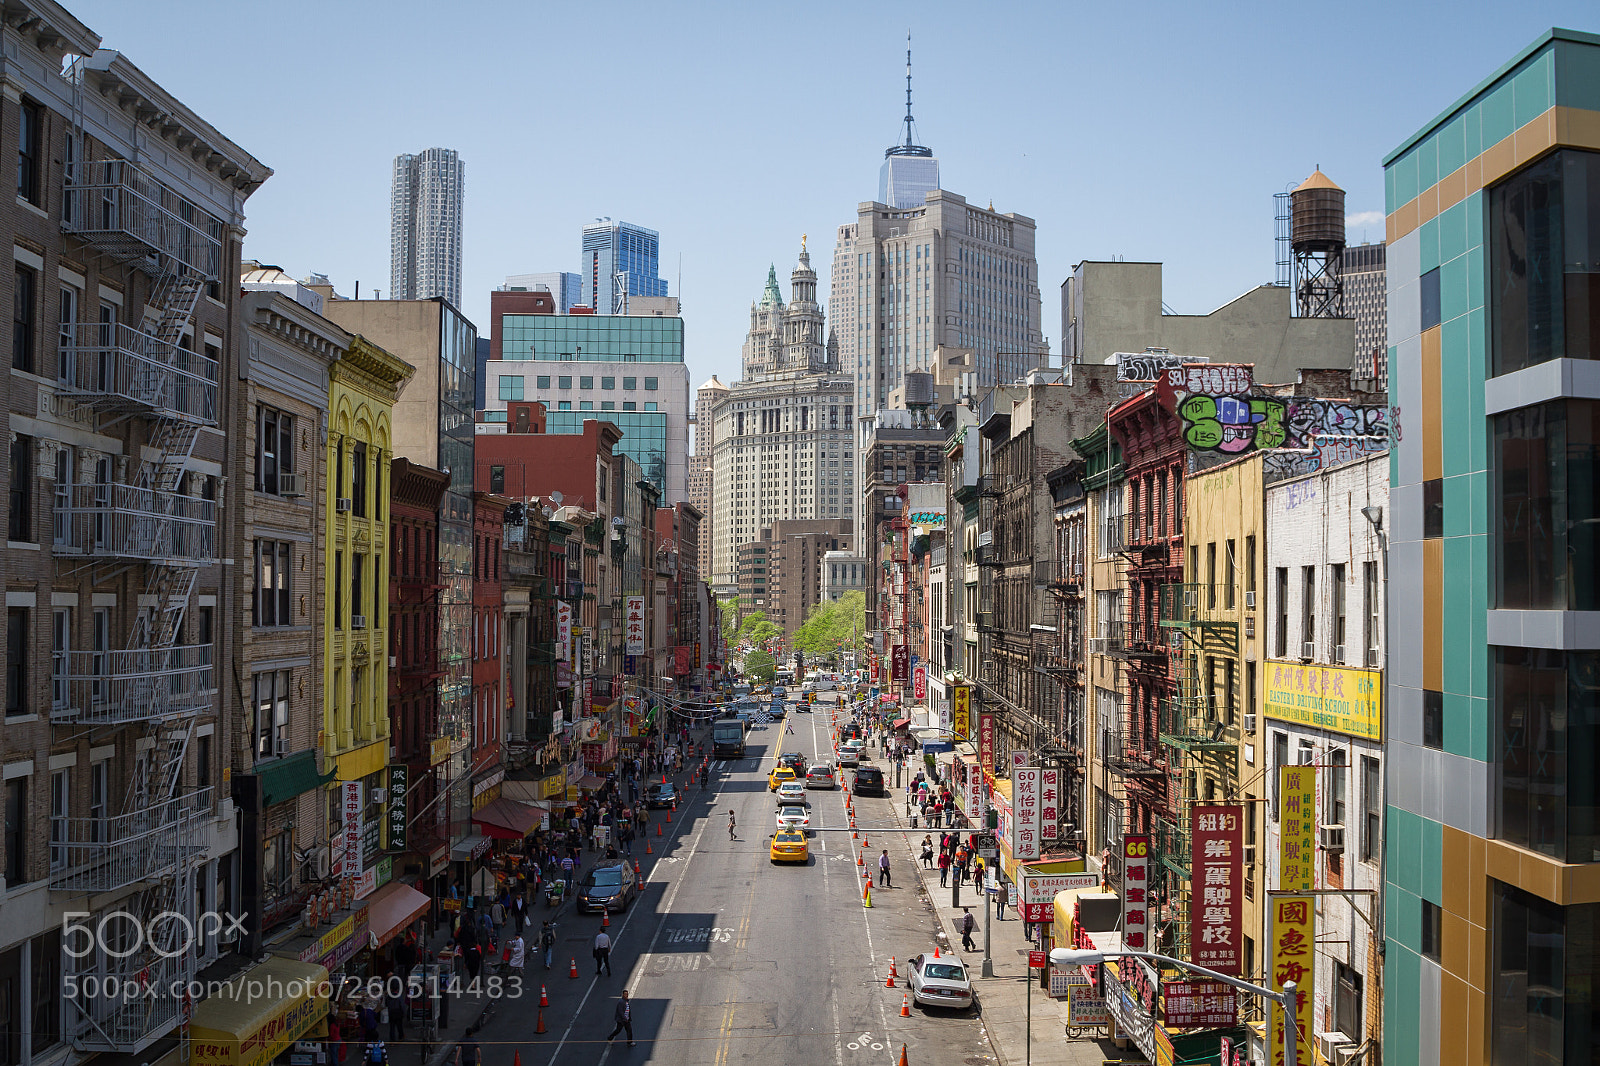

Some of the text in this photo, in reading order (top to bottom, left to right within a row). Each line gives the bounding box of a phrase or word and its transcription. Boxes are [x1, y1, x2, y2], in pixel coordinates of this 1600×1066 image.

[1270, 690, 1295, 706] EASTERN
[1297, 691, 1323, 710] DRIVING
[1325, 698, 1351, 715] SCHOOL
[1198, 813, 1236, 831] 紐約
[1284, 772, 1301, 889] 廣州駕駛學
[1126, 842, 1147, 856] 66
[1202, 839, 1232, 945] 第一駕駛學校
